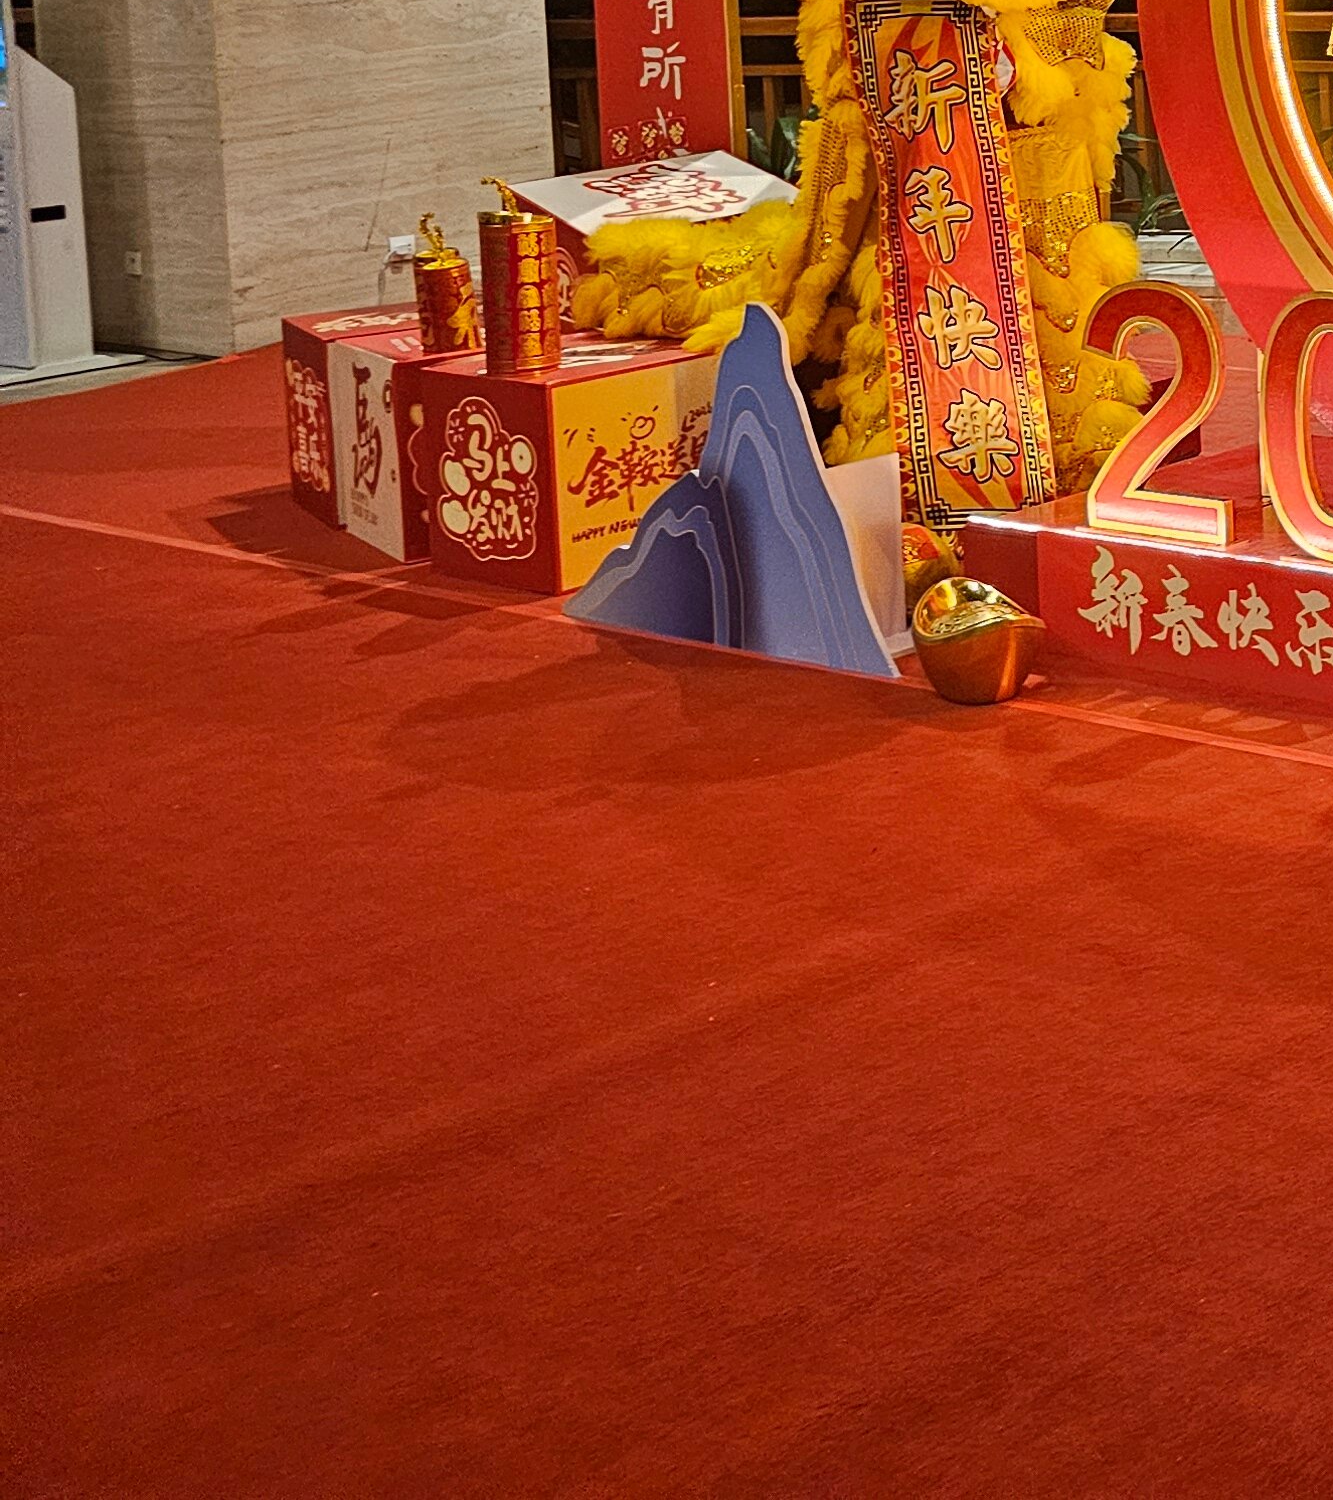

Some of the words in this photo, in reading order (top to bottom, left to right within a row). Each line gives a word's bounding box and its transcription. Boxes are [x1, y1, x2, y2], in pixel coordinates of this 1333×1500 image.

[883, 50, 1021, 485] 新年快樂
[572, 526, 606, 544] HAPPY
